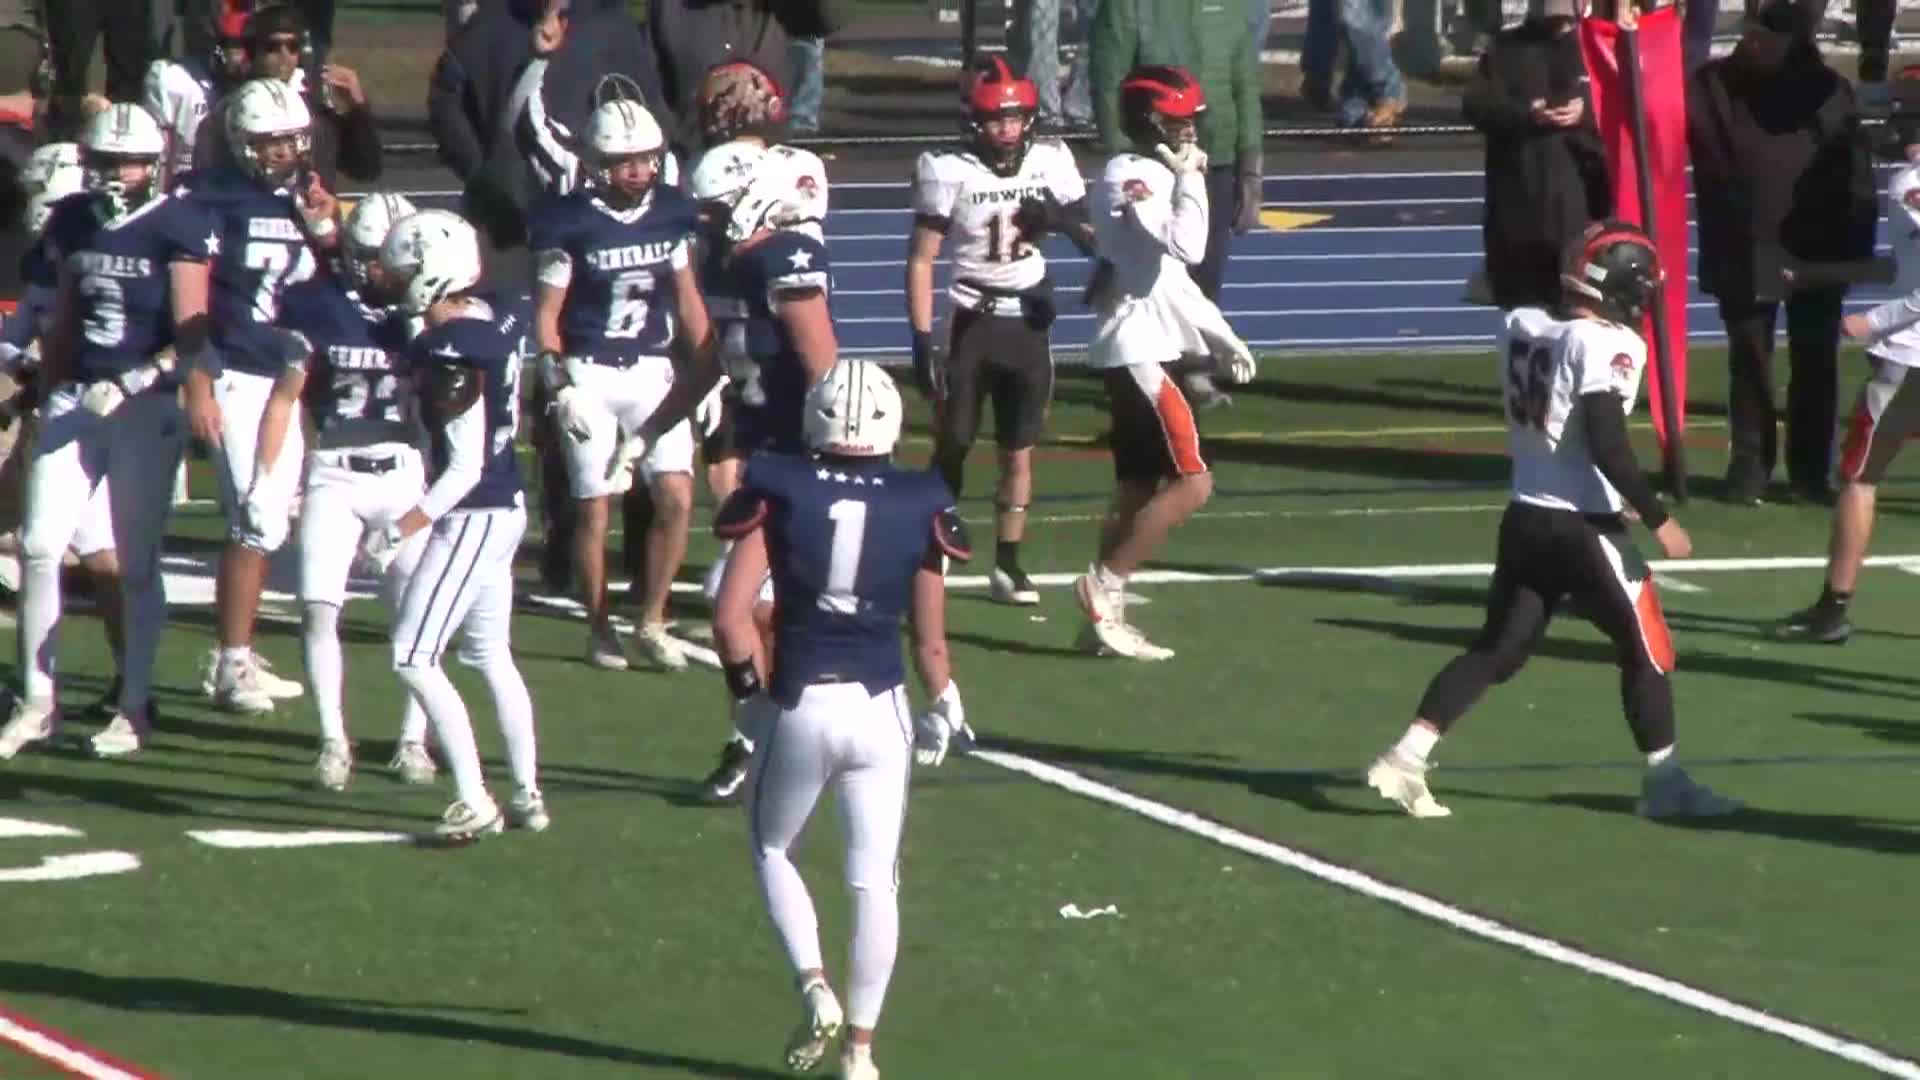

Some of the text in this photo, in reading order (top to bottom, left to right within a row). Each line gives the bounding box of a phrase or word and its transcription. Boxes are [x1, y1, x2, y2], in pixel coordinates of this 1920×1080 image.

[81, 276, 125, 346] 3
[604, 270, 655, 339] 6
[816, 499, 867, 614] 1
